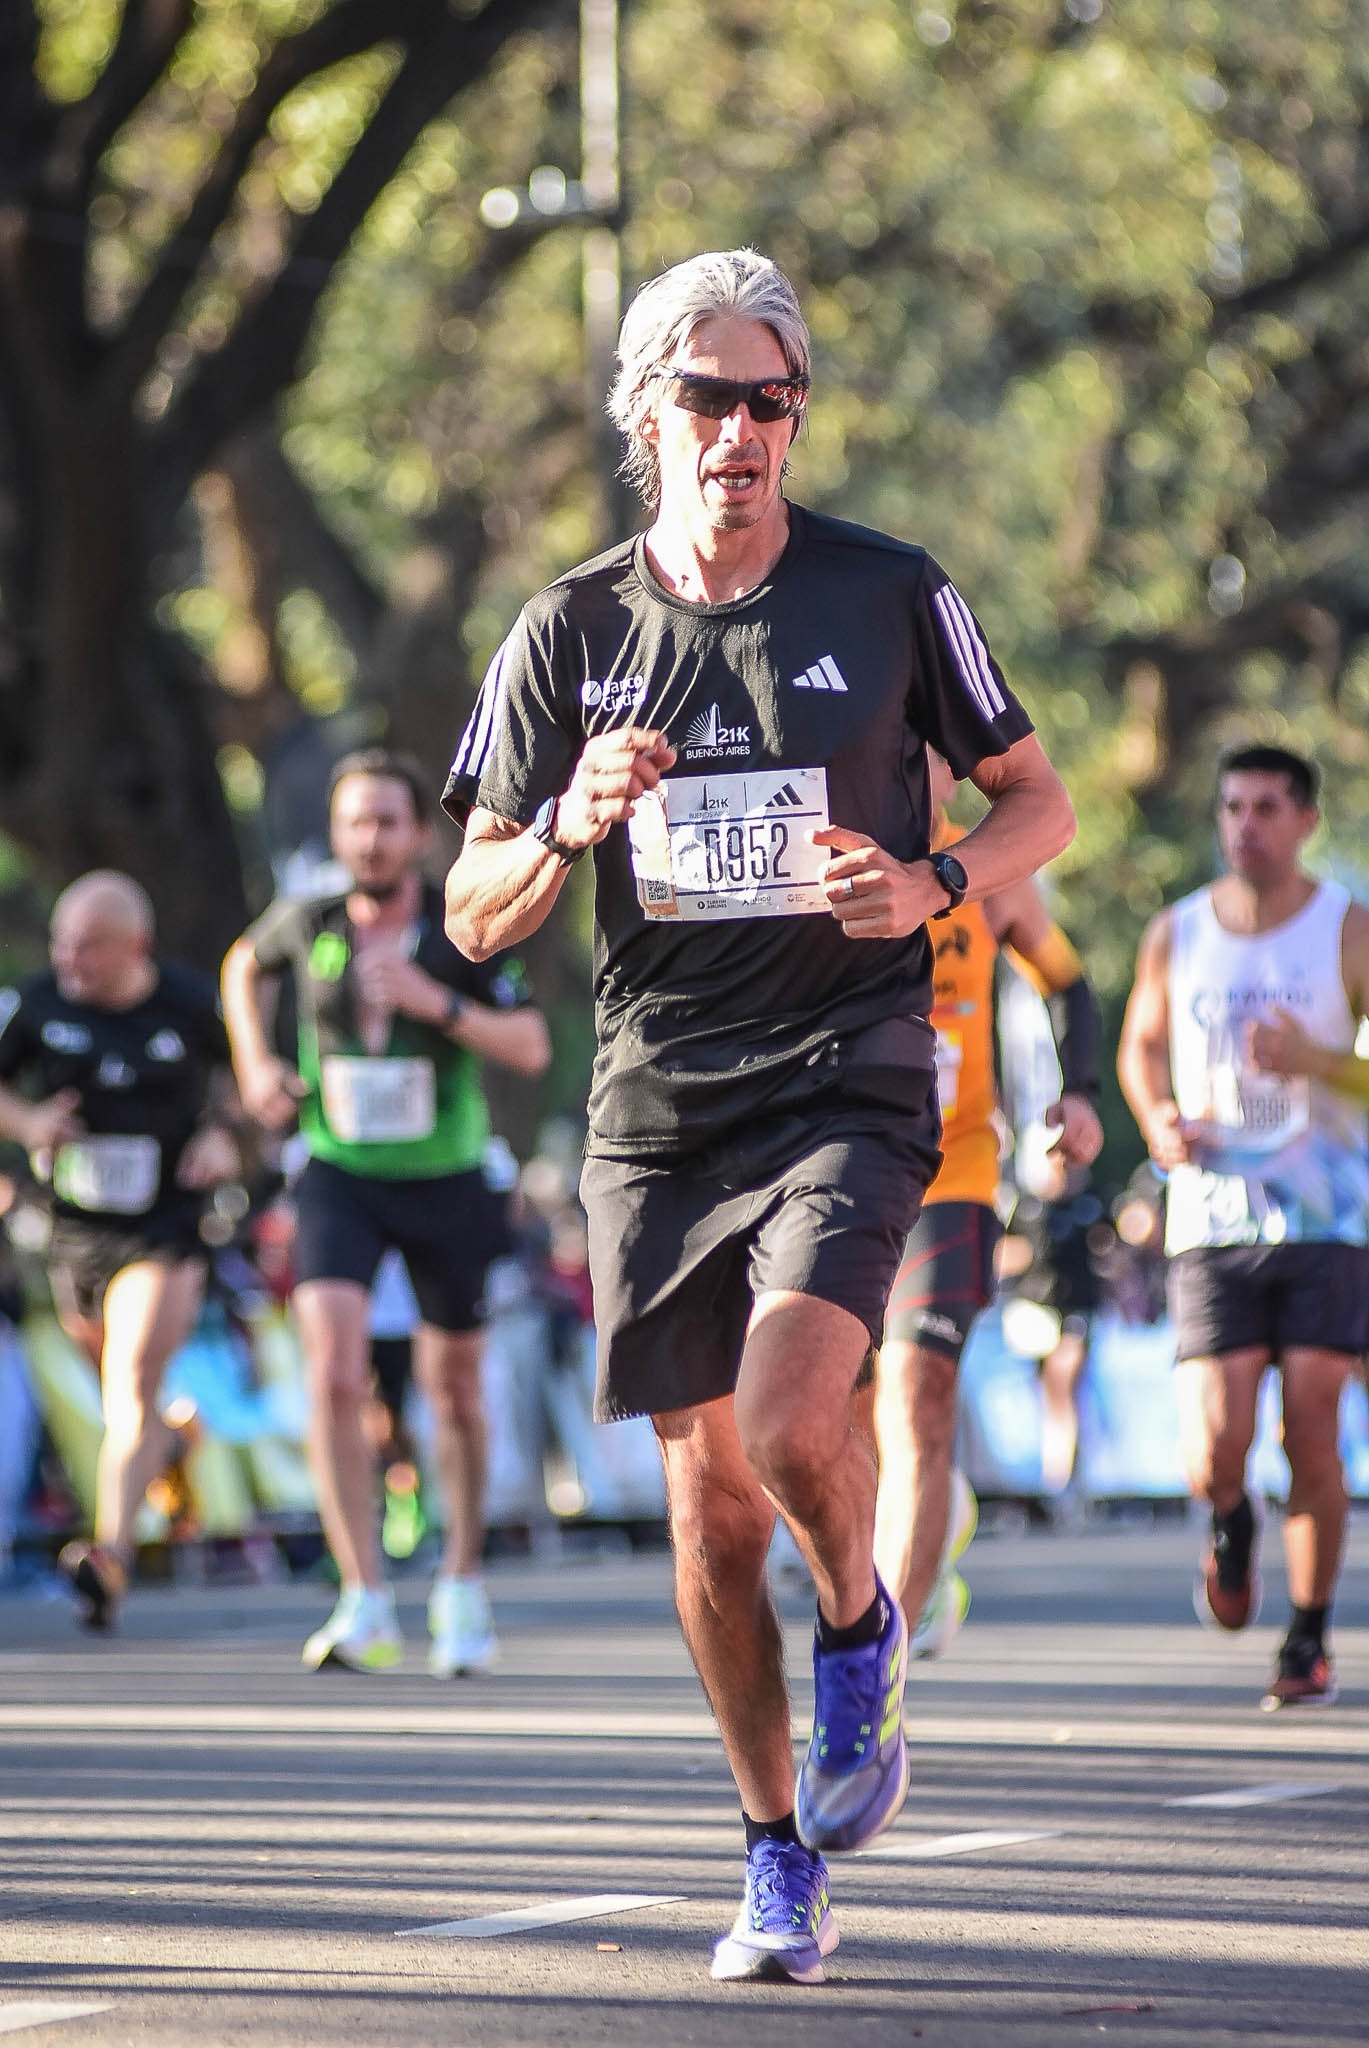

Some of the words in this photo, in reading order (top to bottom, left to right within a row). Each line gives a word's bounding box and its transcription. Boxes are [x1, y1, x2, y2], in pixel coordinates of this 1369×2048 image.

[717, 726, 750, 743] 21K
[686, 747, 724, 760] BUENOS
[725, 745, 750, 756] AIRES
[708, 798, 729, 809] 21K
